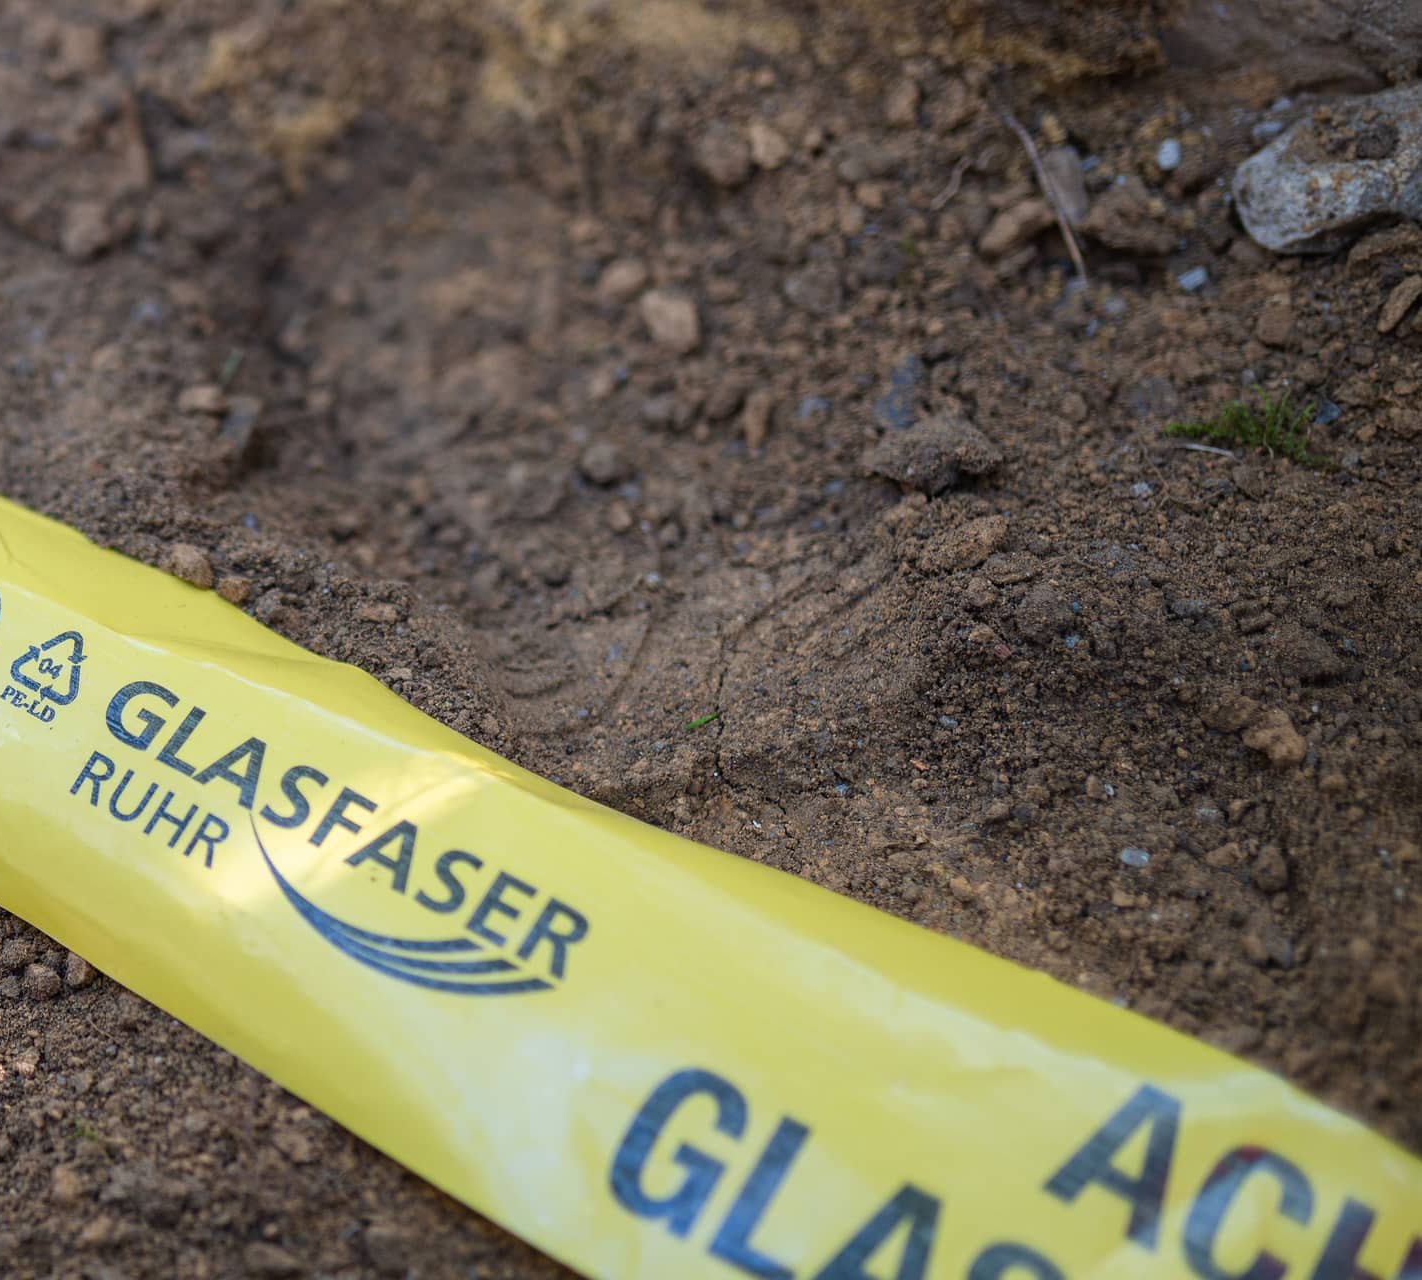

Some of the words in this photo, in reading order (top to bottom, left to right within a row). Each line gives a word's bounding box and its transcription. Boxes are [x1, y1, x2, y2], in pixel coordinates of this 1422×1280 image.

[0, 685, 56, 723] PE-LD
[38, 657, 63, 680] 04
[69, 750, 231, 869] RUHR
[105, 680, 590, 981] GLASFASER
